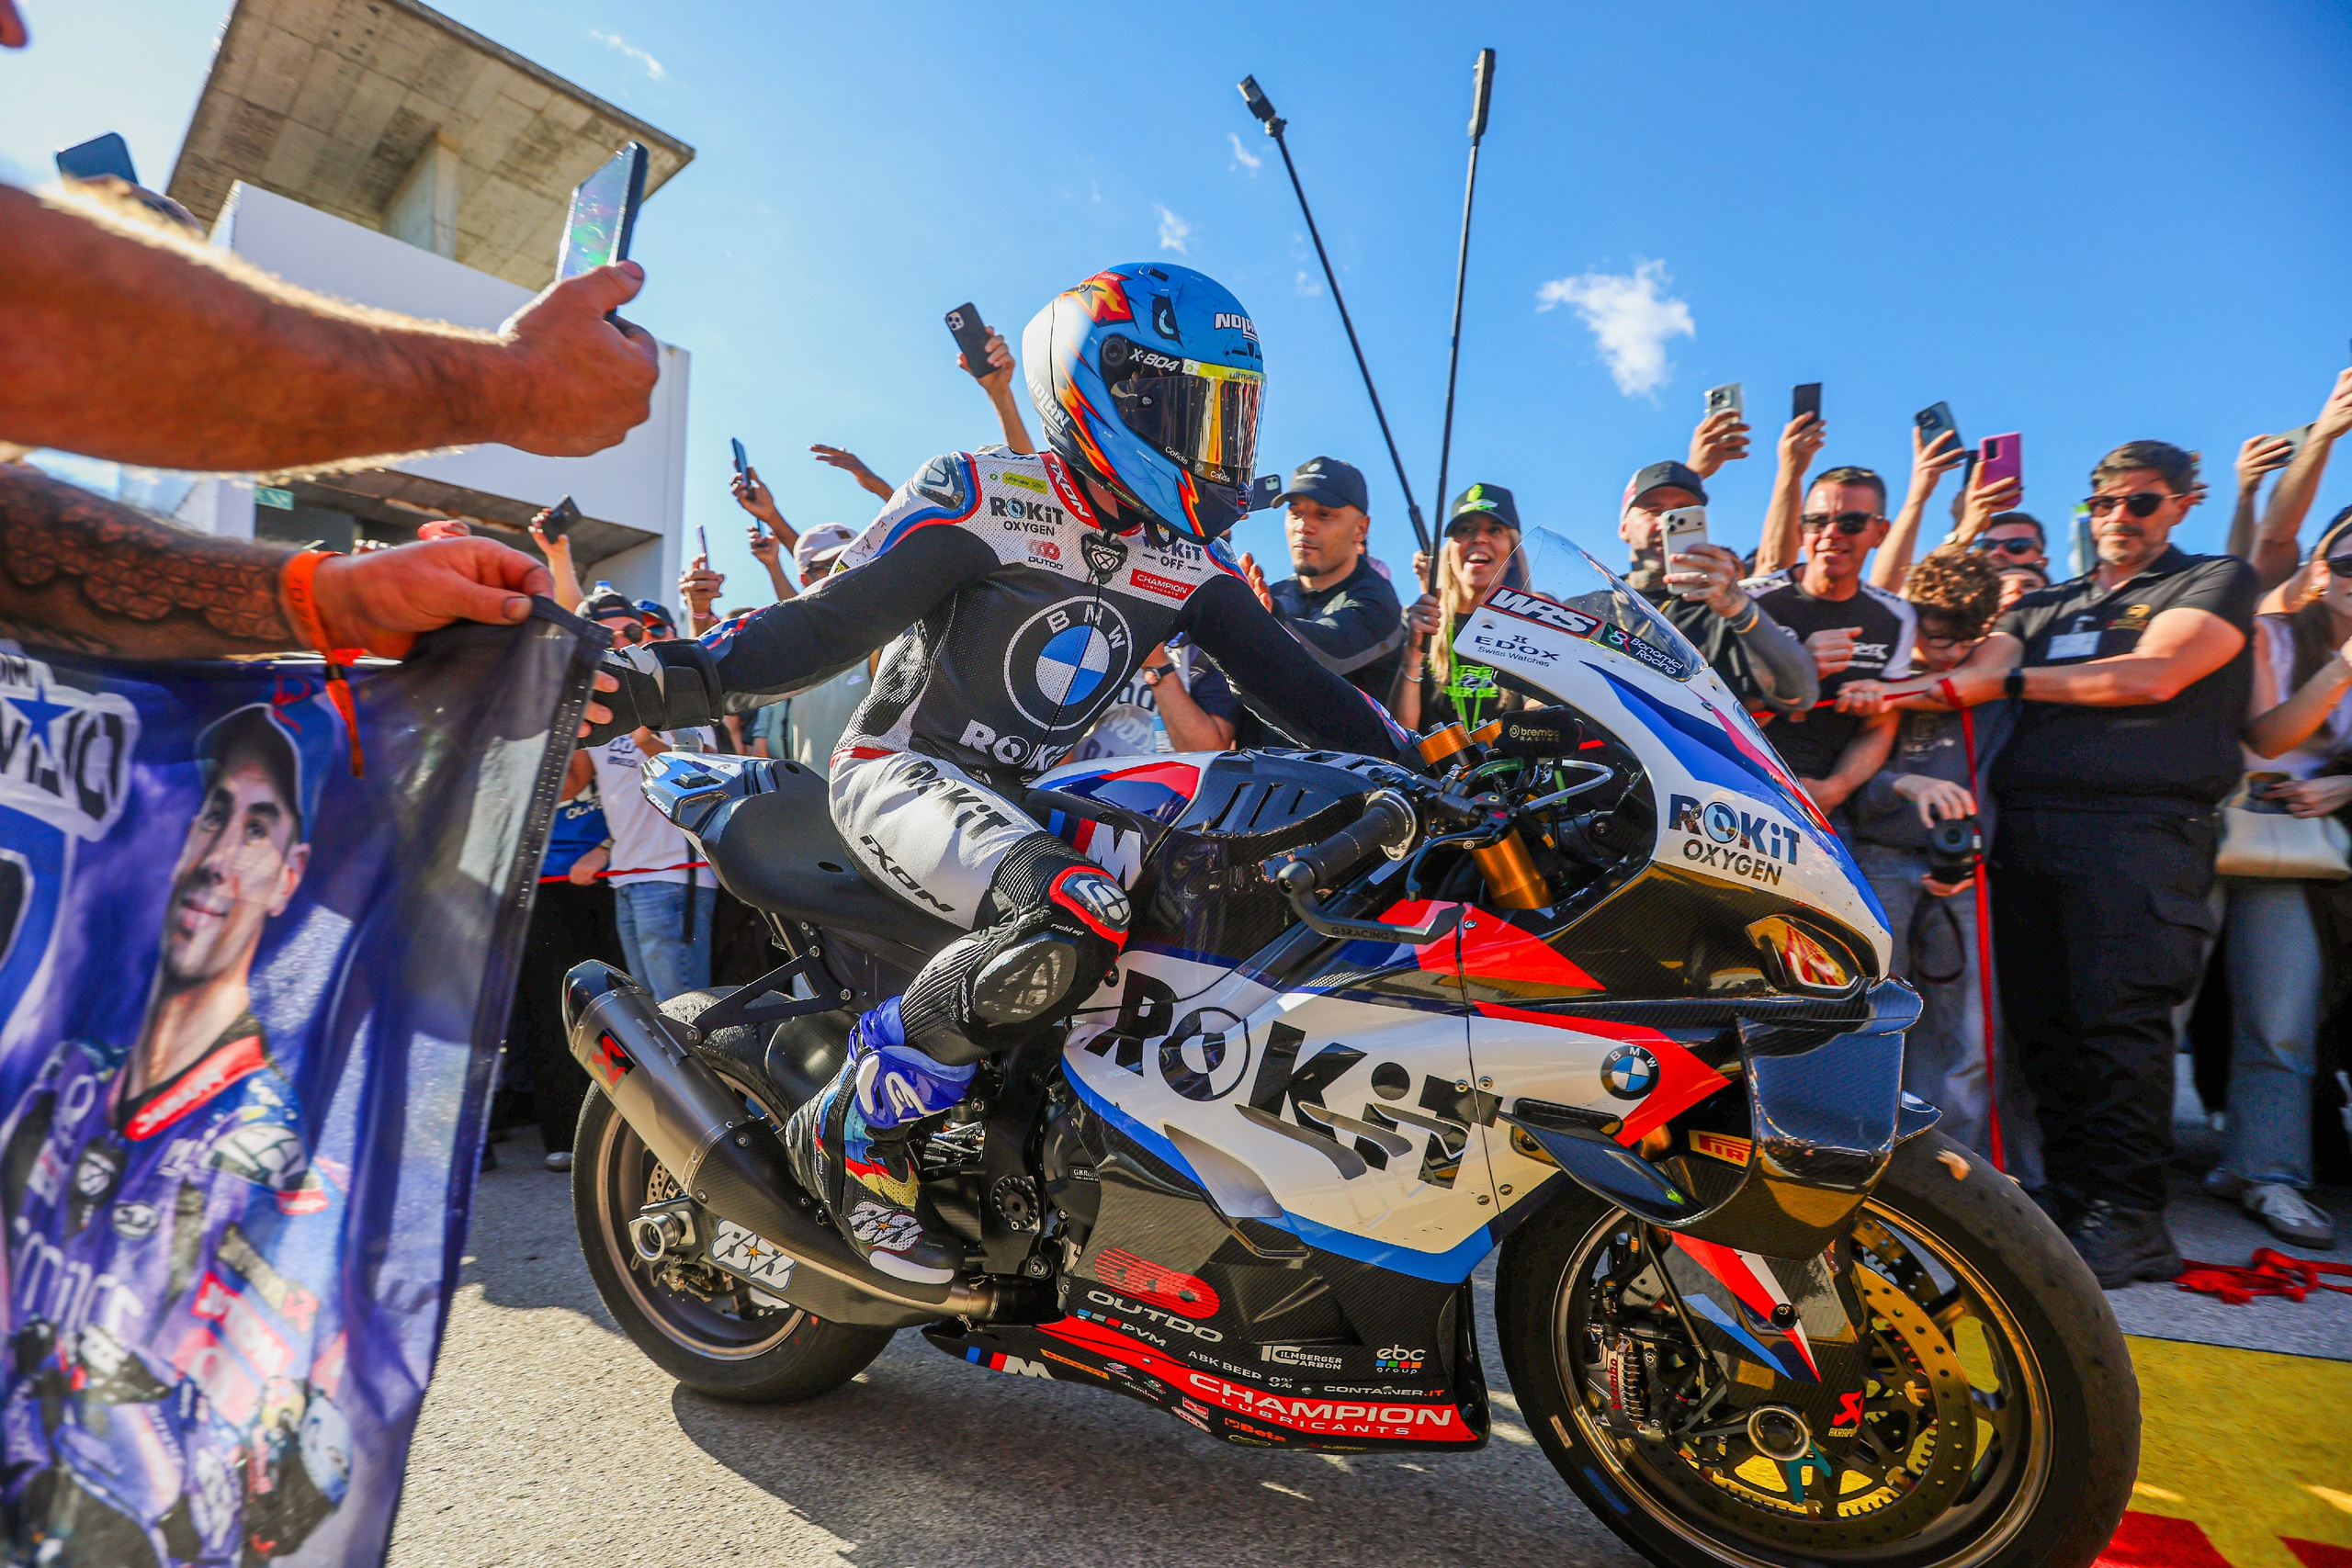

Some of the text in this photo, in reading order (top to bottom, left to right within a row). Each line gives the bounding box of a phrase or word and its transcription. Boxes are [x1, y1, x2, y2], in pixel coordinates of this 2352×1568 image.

[1129, 348, 1180, 372] X-804
[1026, 369, 1070, 432] NOLAN
[1165, 446, 1188, 465] Cofidis
[1003, 521, 1055, 536] OXYGEN
[1160, 556, 1184, 570] OFF
[1136, 574, 1189, 594] CHAMPION
[1490, 588, 1597, 632] WRS
[1046, 604, 1125, 649] BMW
[1475, 635, 1561, 661] EDOX
[1477, 646, 1550, 668] Swiss Watches
[1635, 650, 1677, 675] Racing
[1521, 728, 1559, 737] brembo
[1683, 839, 1781, 886] OXYGEN
[1331, 926, 1389, 941] GBRACING
[1610, 1046, 1657, 1068] BMW
[1698, 1134, 1752, 1162] PIR
[1087, 1290, 1223, 1342] OUTDO
[1121, 1322, 1167, 1347] PVM
[1280, 1351, 1342, 1364] ILMBERGER
[1376, 1344, 1426, 1361] ebc
[1188, 1350, 1219, 1367] ABK
[1222, 1361, 1262, 1380] BEER
[1376, 1367, 1418, 1375] group
[1607, 1358, 1623, 1410] brembo
[1189, 1373, 1452, 1427] CHAMPION
[1221, 1398, 1409, 1436] LUBRICANTS
[1240, 1422, 1286, 1443] Beta
